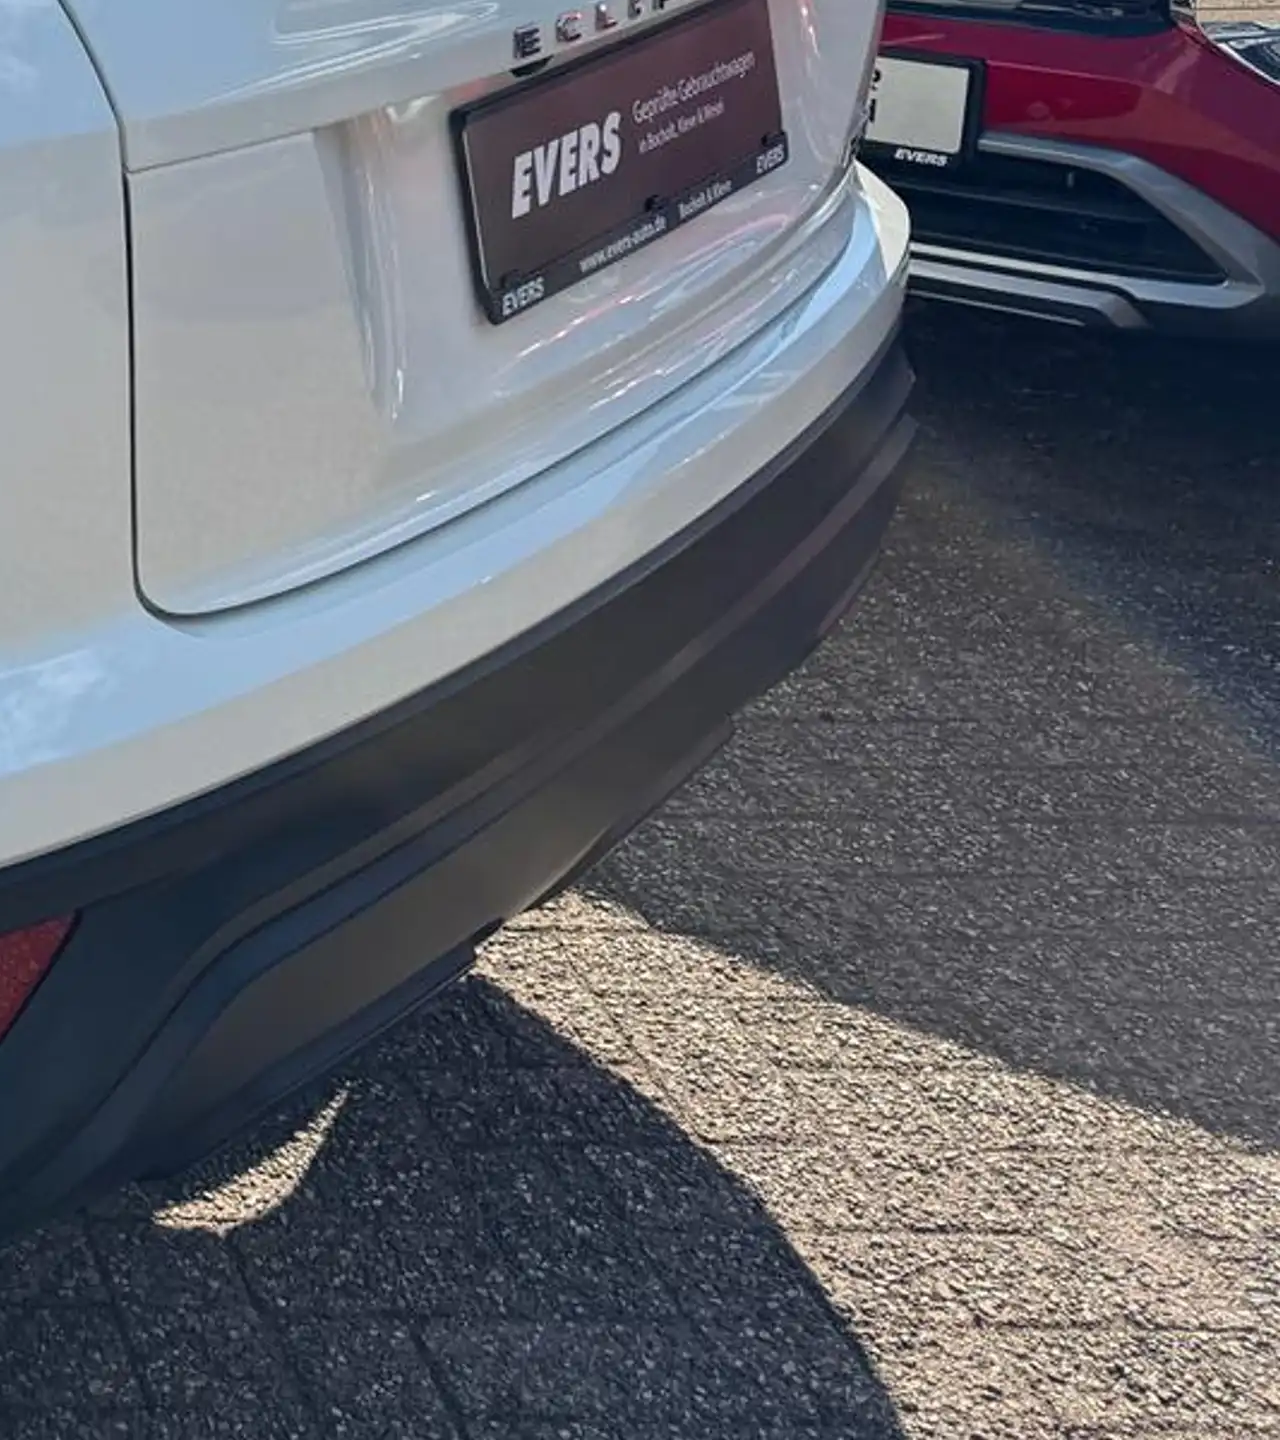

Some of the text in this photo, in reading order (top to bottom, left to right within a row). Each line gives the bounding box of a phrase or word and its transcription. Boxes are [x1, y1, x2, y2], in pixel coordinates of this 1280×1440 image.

[632, 86, 679, 124] Geprüfte
[511, 111, 622, 220] EVERS
[755, 143, 785, 174] EVERS
[894, 148, 948, 167] EVERS
[502, 277, 545, 316] EVERS
